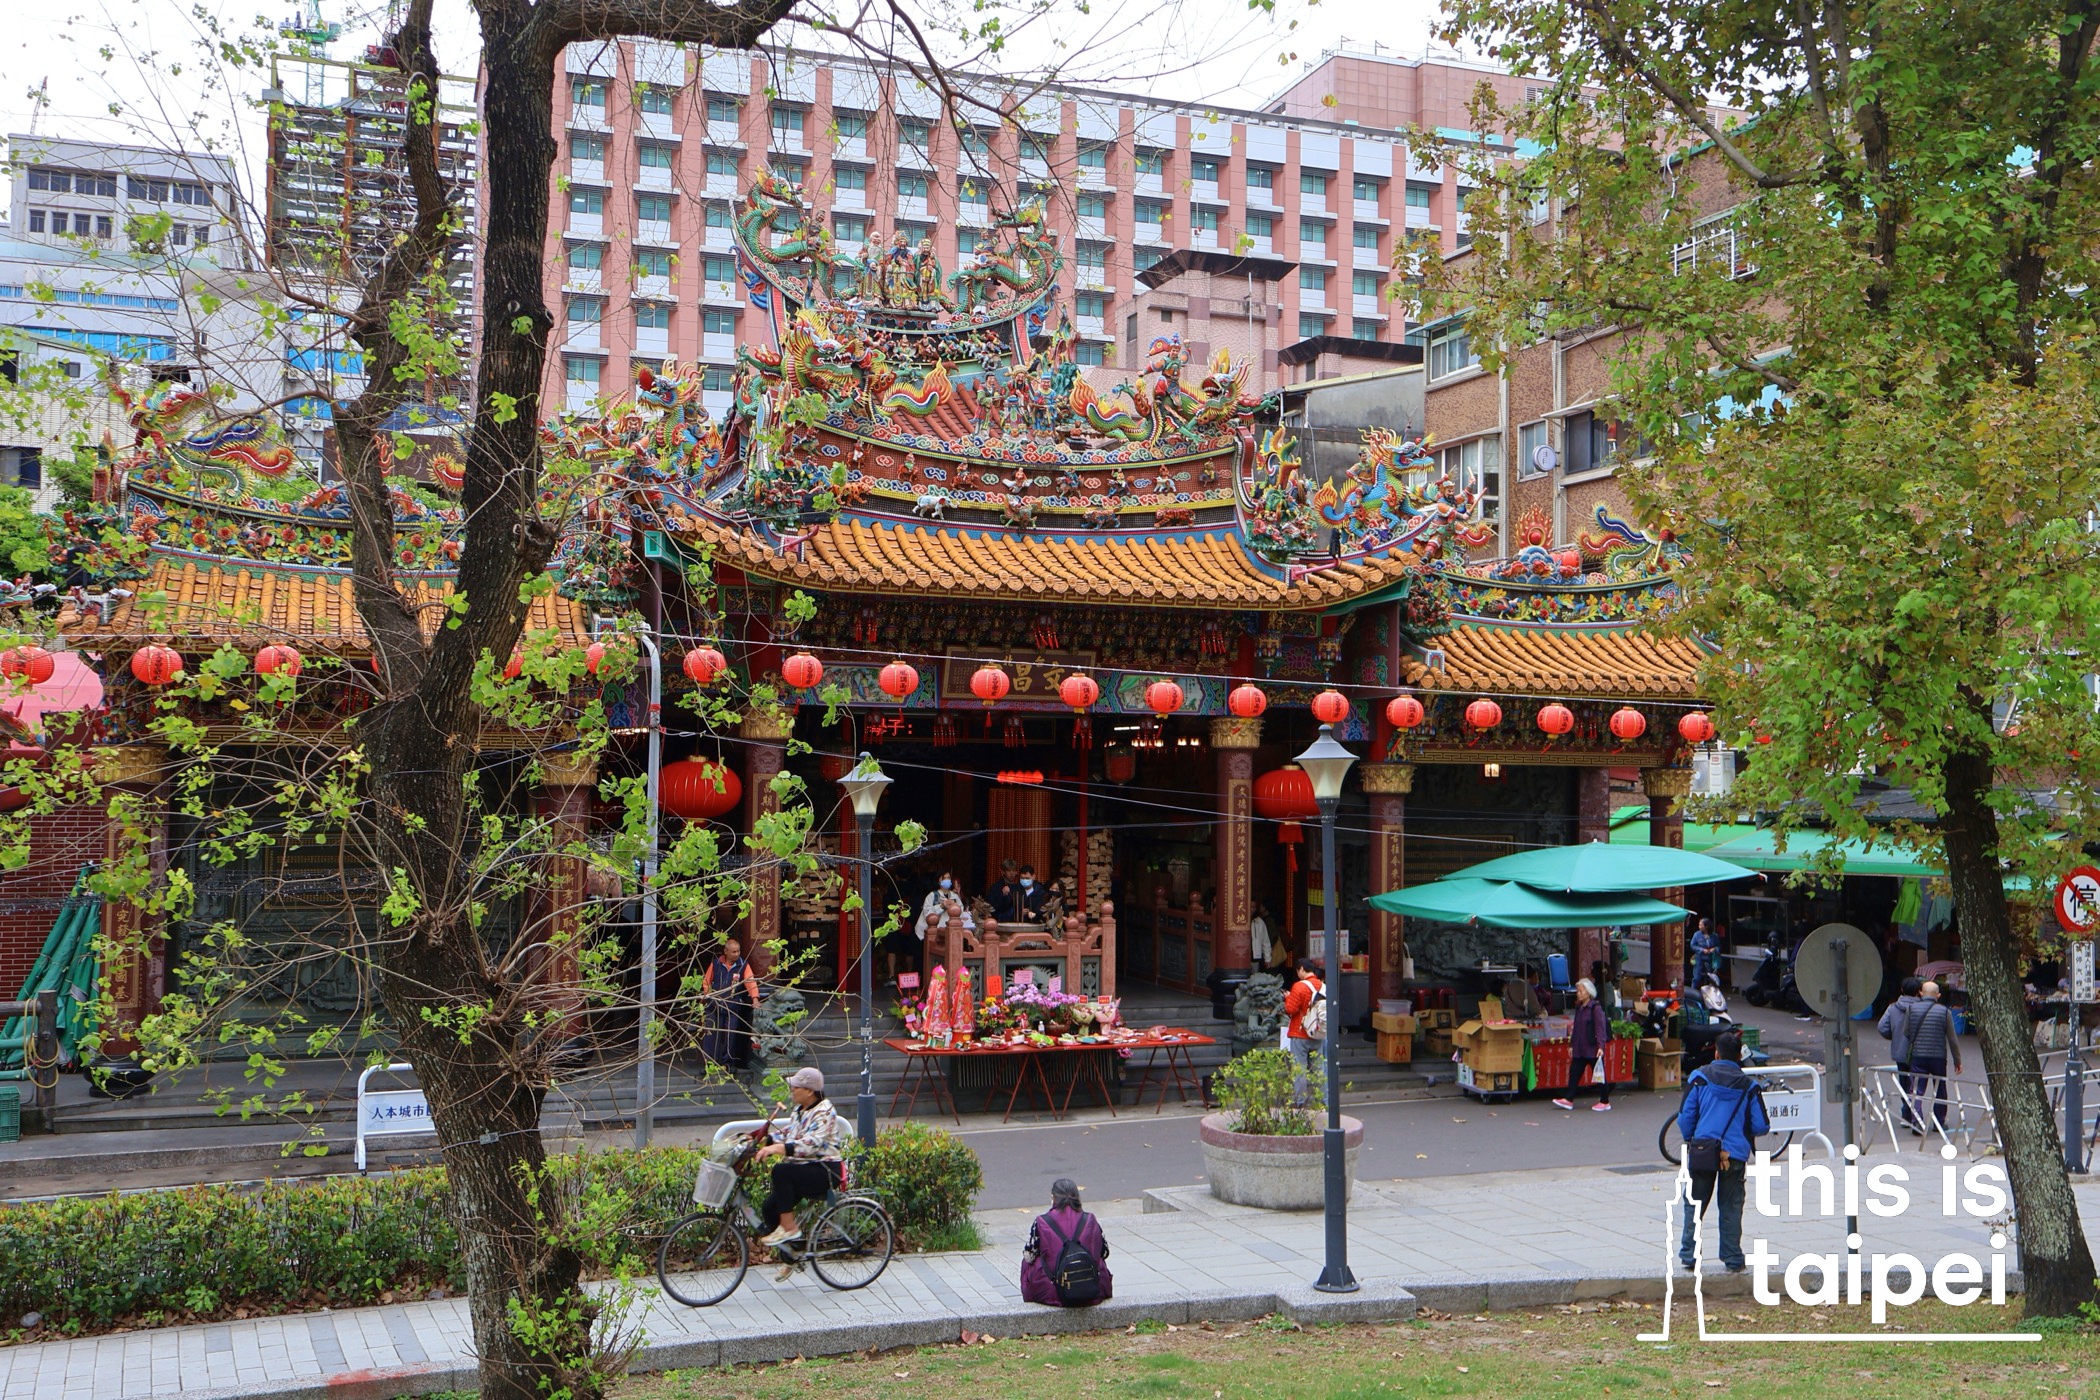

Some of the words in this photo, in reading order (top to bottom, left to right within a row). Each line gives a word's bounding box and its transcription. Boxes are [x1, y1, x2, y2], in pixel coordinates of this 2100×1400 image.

[2070, 884, 2096, 919] 停
[1765, 1104, 1799, 1118] 道通行
